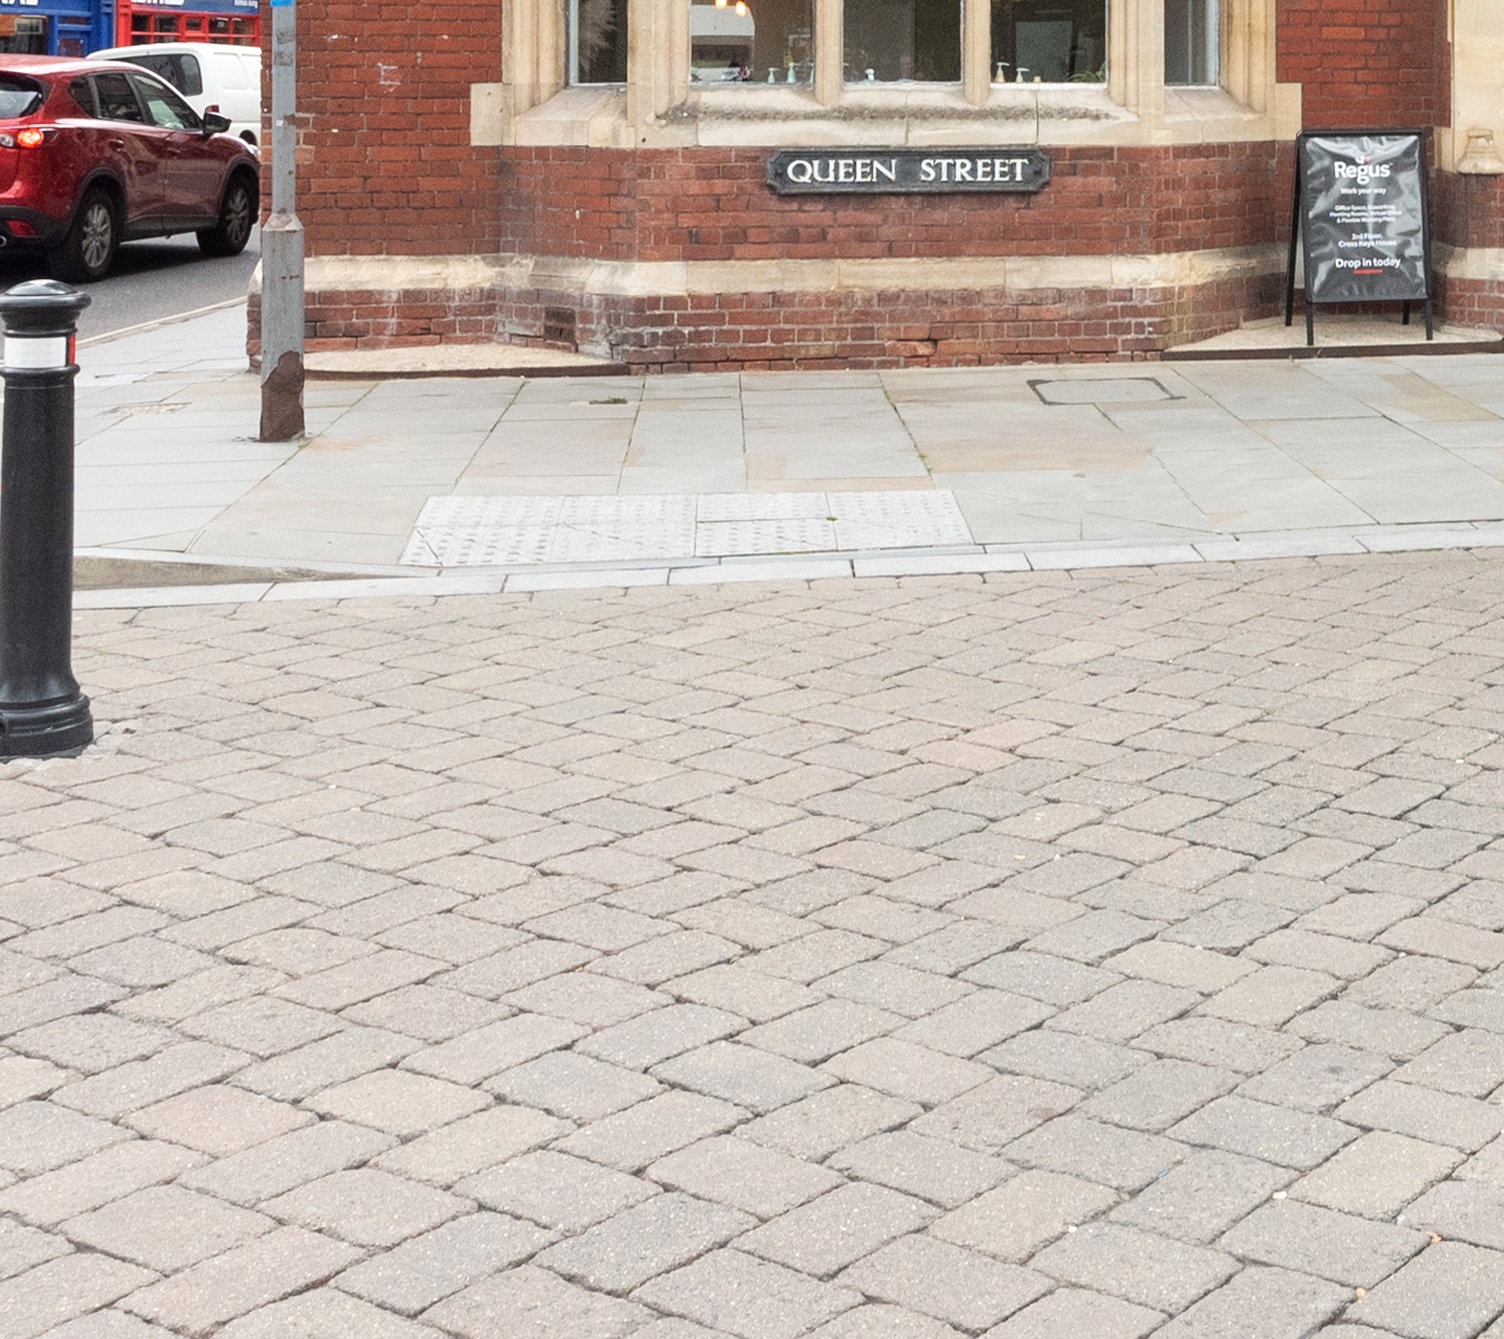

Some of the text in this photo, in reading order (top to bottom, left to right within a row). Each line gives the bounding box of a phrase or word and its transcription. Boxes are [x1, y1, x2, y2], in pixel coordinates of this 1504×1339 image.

[786, 158, 1029, 184] QUEEN STREET
[1334, 155, 1391, 185] Regus
[1340, 187, 1387, 196] Work your way
[1351, 233, 1364, 241] 3rd
[1338, 239, 1397, 249] Cross Keys House
[1335, 257, 1402, 270] Drop in today
